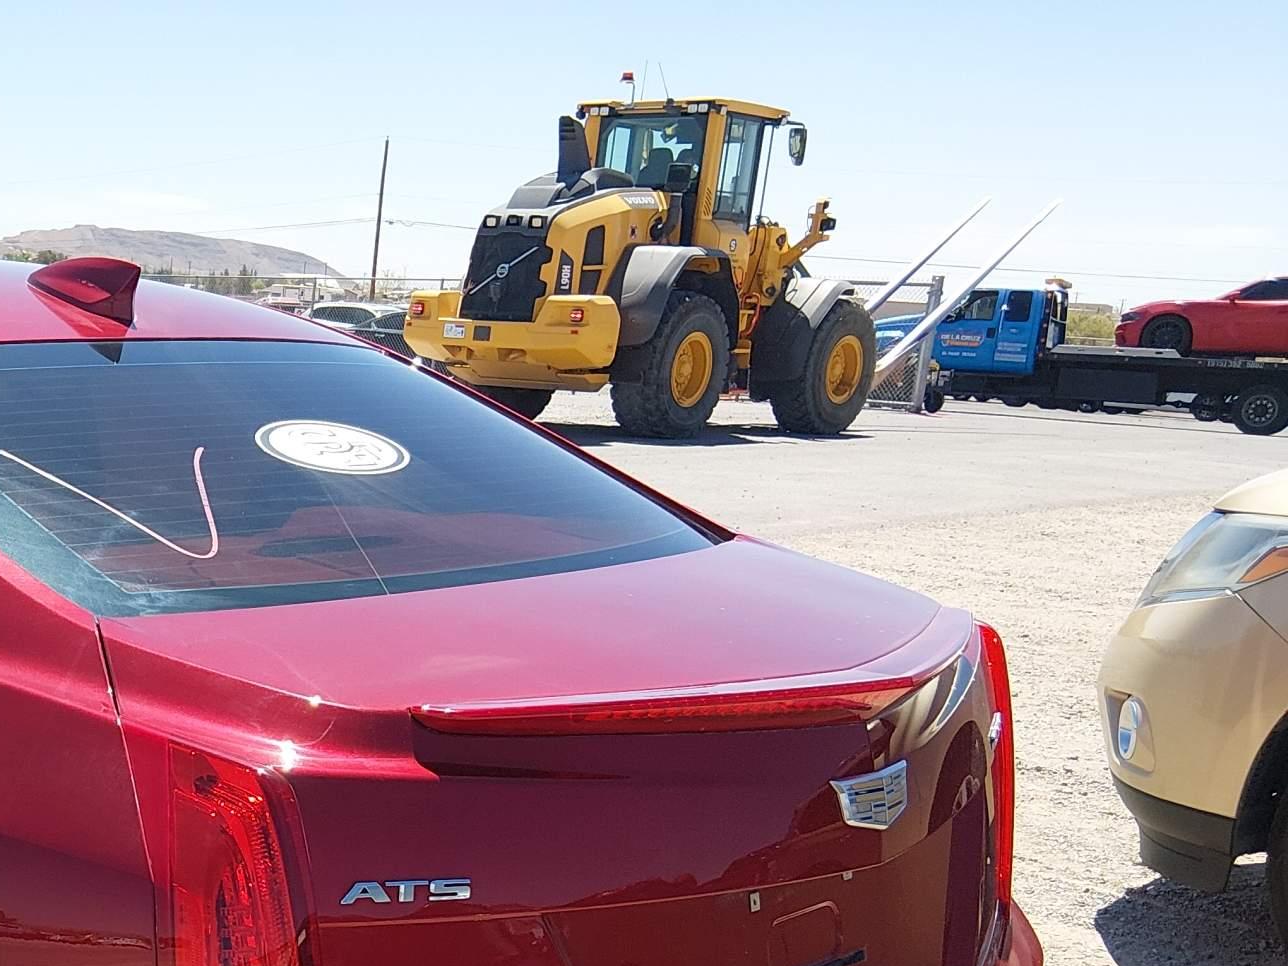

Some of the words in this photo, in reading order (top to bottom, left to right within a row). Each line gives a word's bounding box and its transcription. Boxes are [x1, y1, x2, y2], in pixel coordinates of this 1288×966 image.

[623, 196, 655, 204] VOLVO
[560, 264, 572, 290] L90H
[339, 878, 472, 905] ATS
